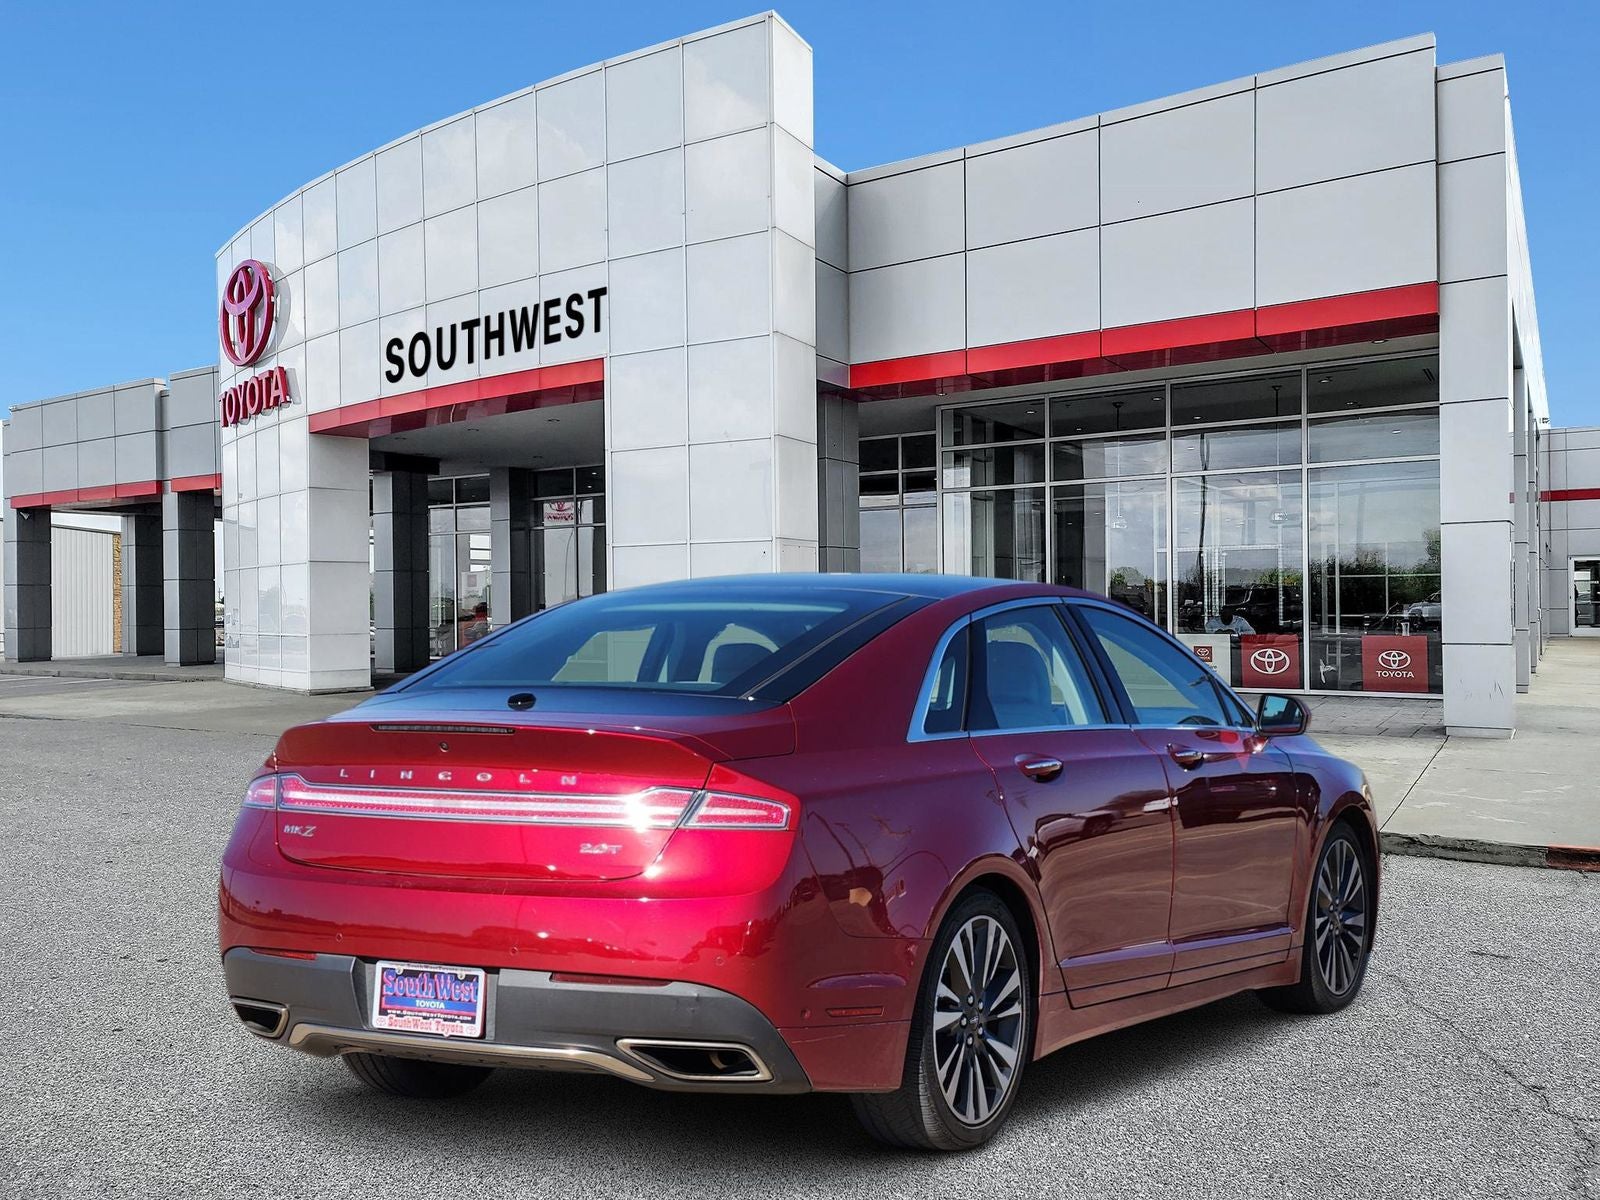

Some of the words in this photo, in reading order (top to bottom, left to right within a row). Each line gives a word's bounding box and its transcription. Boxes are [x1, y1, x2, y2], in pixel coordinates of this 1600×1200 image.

[385, 286, 608, 384] SOUTHWEST
[218, 366, 291, 428] TOYOTA
[1375, 670, 1415, 678] TOYOTA
[339, 768, 577, 786] LINCOLN
[283, 824, 317, 837] MKZ
[415, 999, 446, 1010] TOYOTA
[435, 1019, 465, 1035] Toyota
